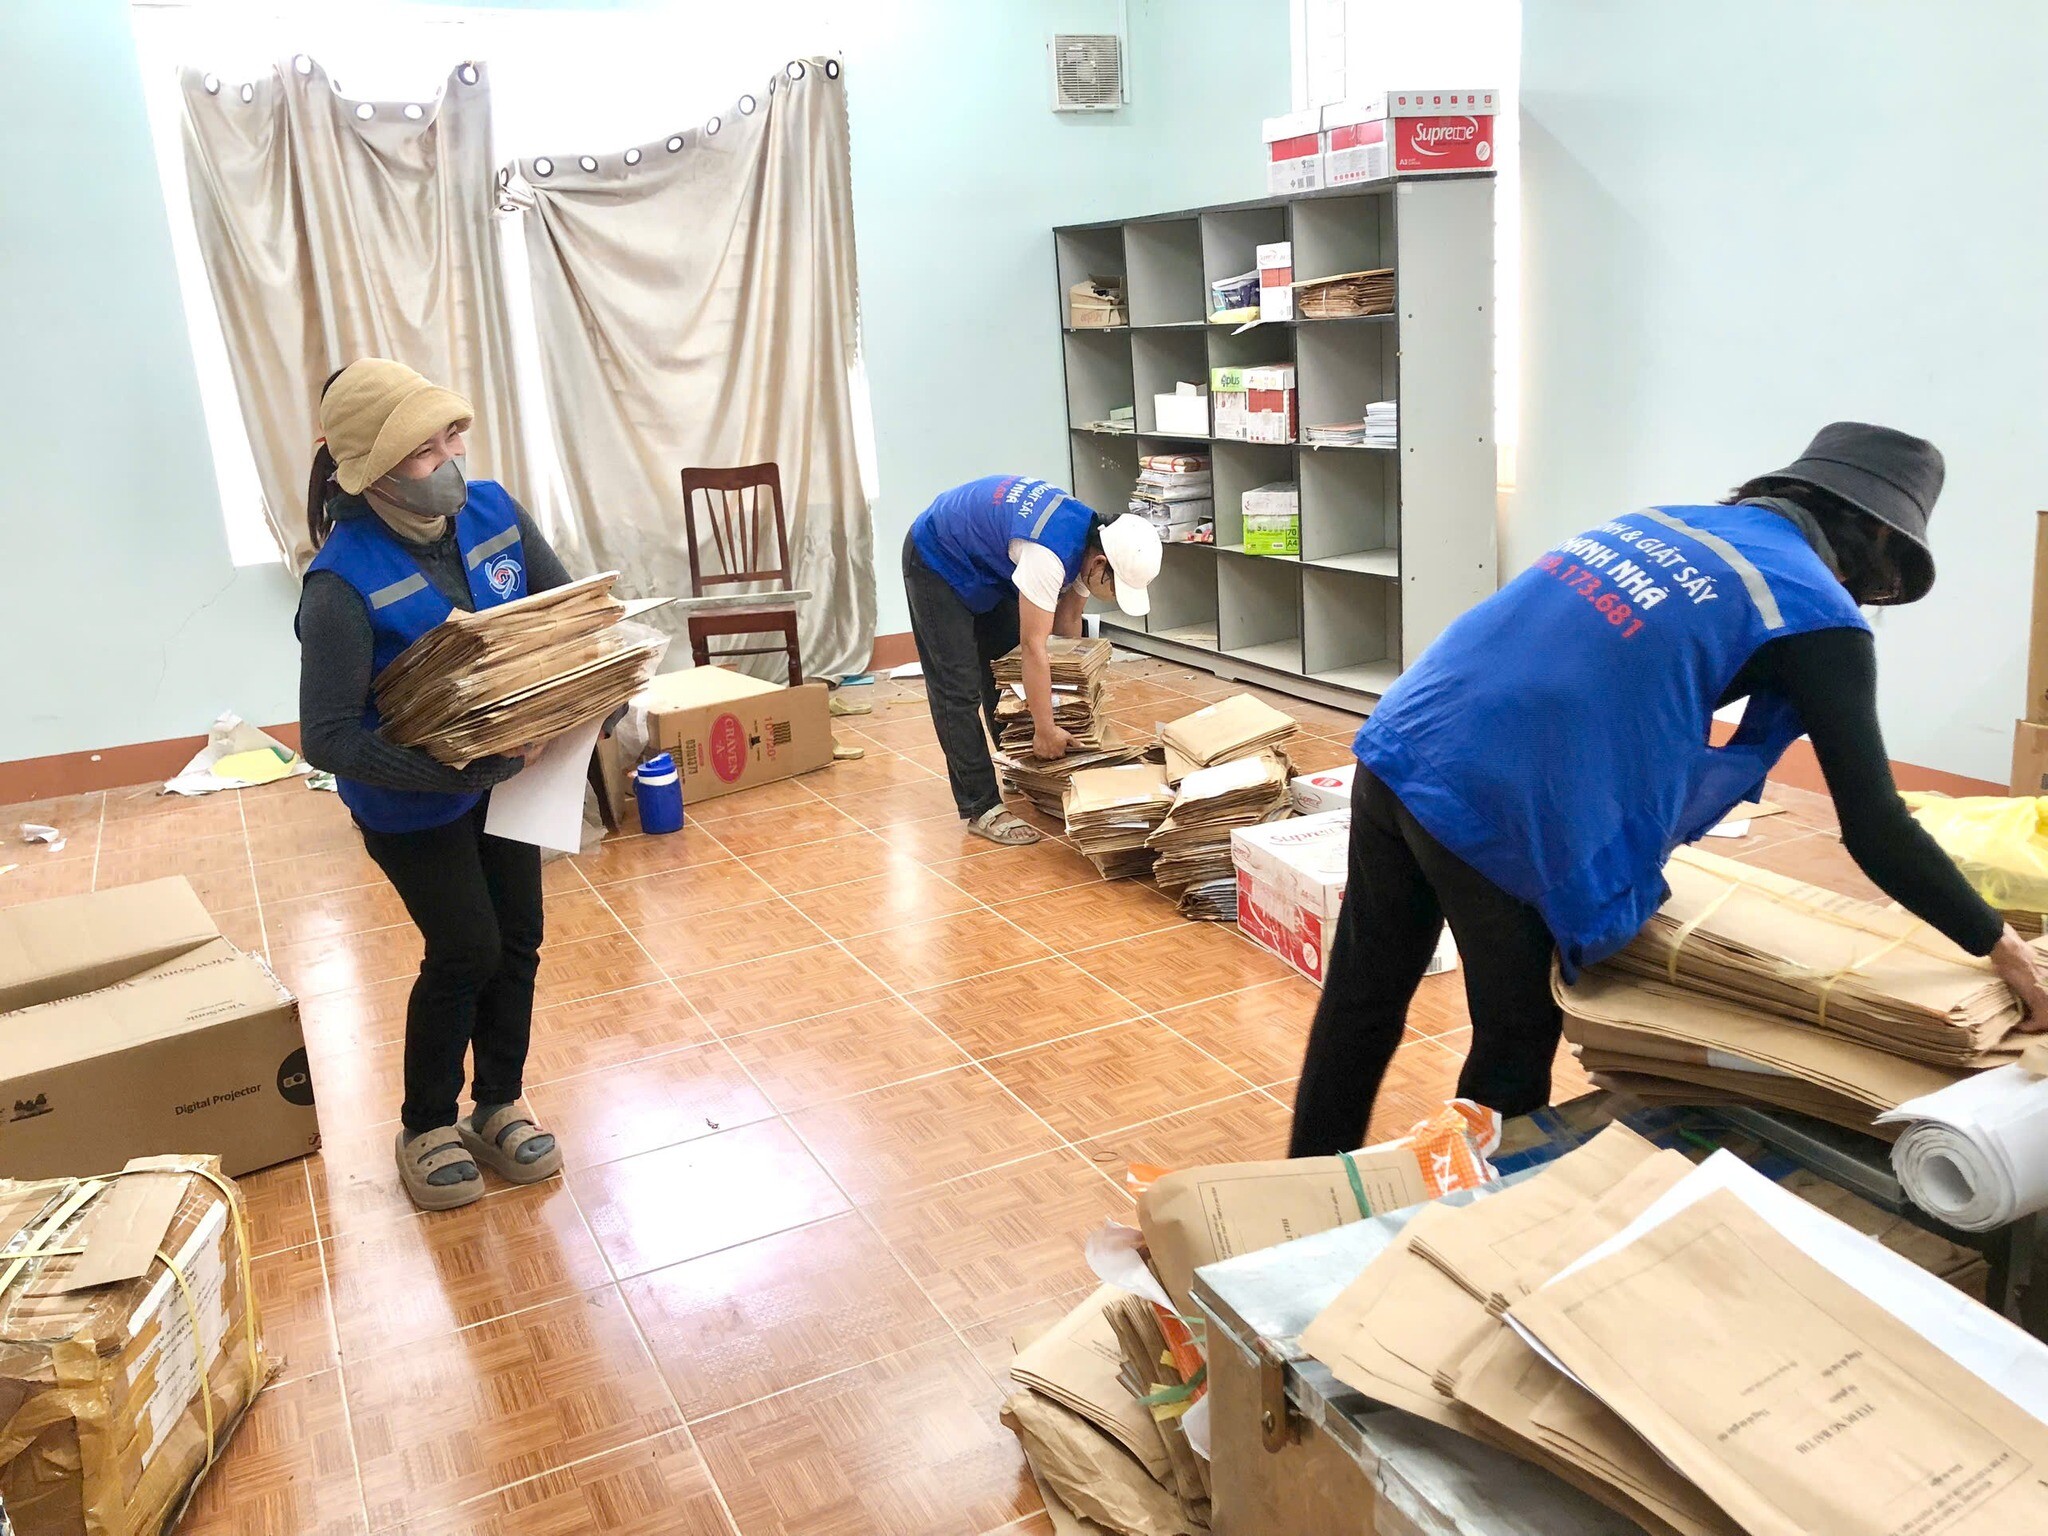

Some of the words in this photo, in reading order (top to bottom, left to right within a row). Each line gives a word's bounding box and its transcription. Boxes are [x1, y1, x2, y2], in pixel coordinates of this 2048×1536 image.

[1672, 565, 1719, 605] SẤY
[724, 717, 740, 775] CRAVEN
[174, 1096, 212, 1117] Digital
[212, 1083, 262, 1106] Projector
